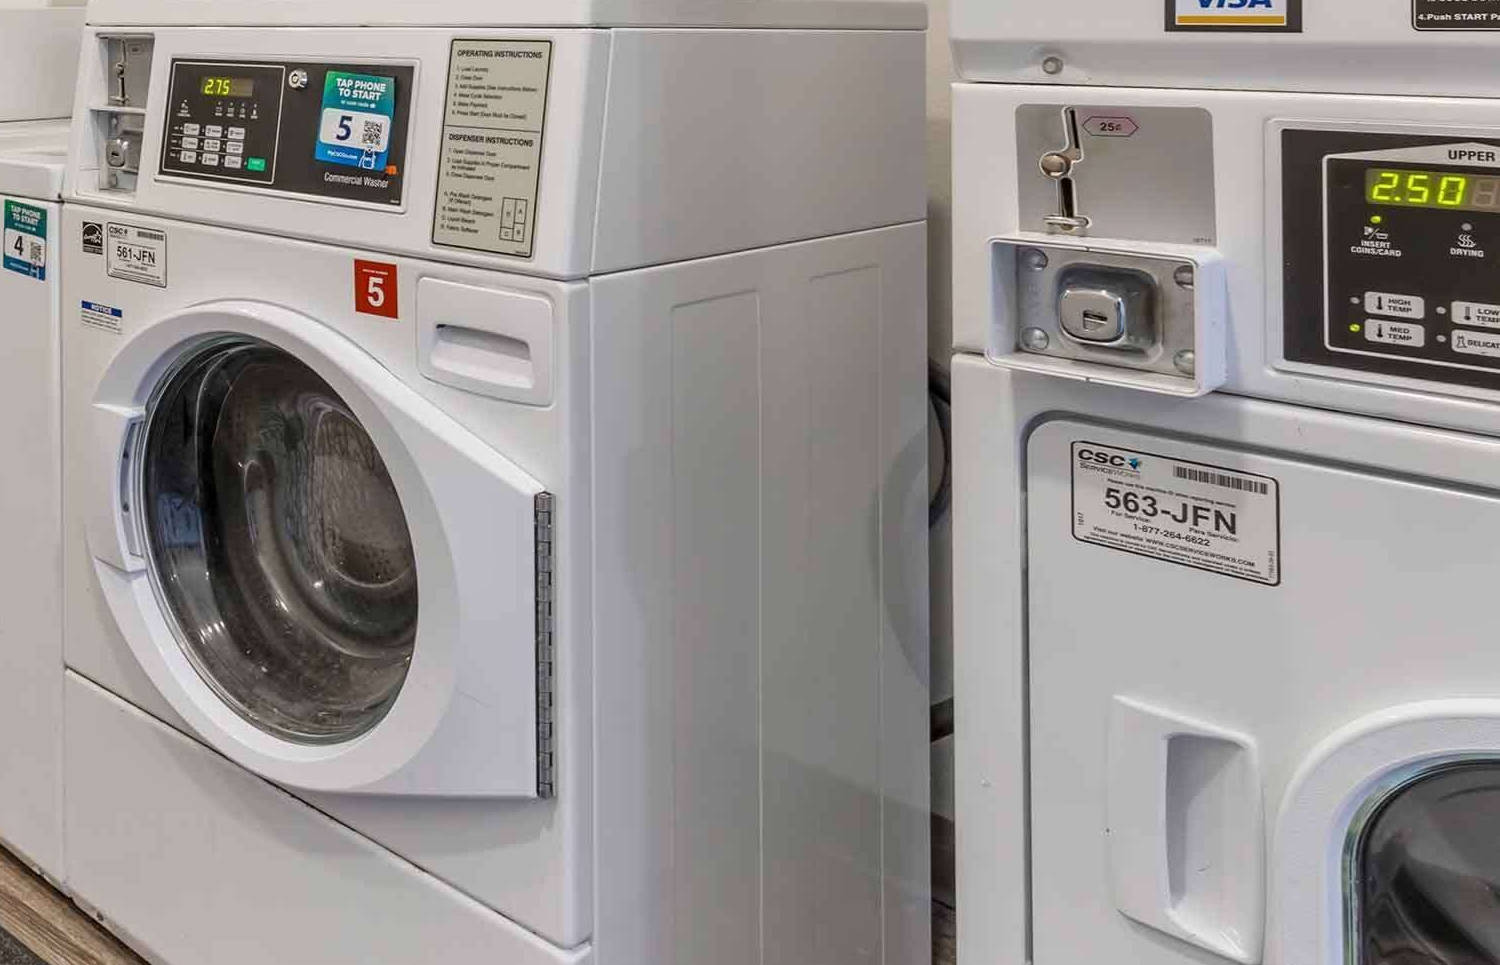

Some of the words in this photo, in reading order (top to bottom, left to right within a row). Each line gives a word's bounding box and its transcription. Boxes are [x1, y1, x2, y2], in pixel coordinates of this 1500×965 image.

[1454, 13, 1487, 21] START
[494, 51, 543, 59] INSTRUCTIONS
[203, 78, 231, 96] 2.75
[336, 78, 353, 88] TAP
[355, 80, 386, 92] PHONE
[338, 87, 350, 97] TO
[352, 90, 381, 101] START
[335, 115, 353, 141] 5
[449, 133, 484, 143] DISPENSER
[485, 136, 533, 147] INSTRUCTIONS
[1448, 150, 1496, 162] UPPER
[324, 172, 363, 185] Commercial
[364, 176, 388, 188] Washer
[1372, 172, 1466, 206] 2.50
[21, 208, 41, 219] PHONE
[21, 215, 38, 226] START
[14, 236, 23, 256] 4
[1361, 240, 1391, 249] INSERT
[116, 246, 156, 264] 561-JFN
[1350, 245, 1402, 257] COINS/CARD
[1450, 247, 1485, 258] DRYING
[367, 276, 384, 307] 5
[1388, 298, 1411, 307] HIGH
[1388, 305, 1412, 314] TEMP
[1477, 308, 1499, 316] LOW
[1389, 326, 1410, 335] MED
[1388, 333, 1412, 342] TEMP
[1078, 449, 1125, 467] CSC
[1105, 488, 1237, 535] 563-JFN
[1133, 523, 1211, 546] 1-877-264-6622
[1189, 527, 1205, 535] Para
